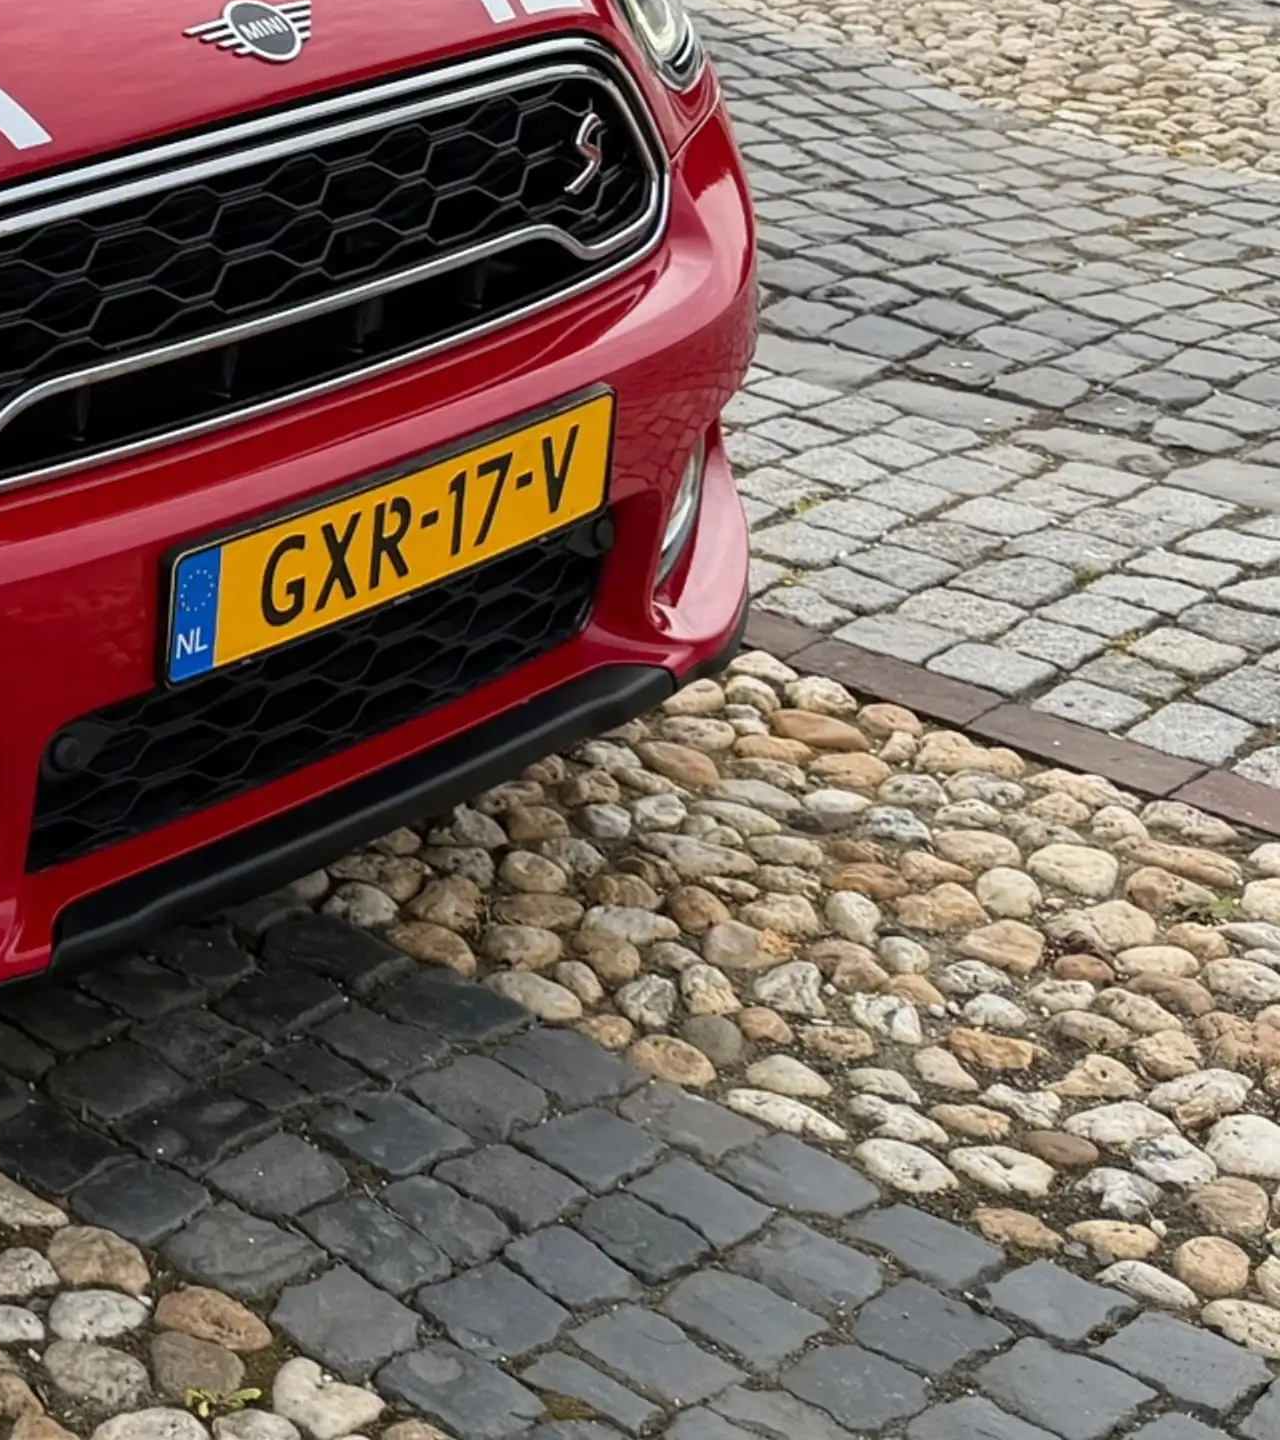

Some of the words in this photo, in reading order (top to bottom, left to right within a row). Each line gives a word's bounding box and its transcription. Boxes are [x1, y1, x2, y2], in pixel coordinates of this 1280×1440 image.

[239, 16, 289, 41] MINI
[565, 113, 602, 194] S
[260, 425, 579, 627] GXR-17-V
[176, 627, 208, 659] NL
